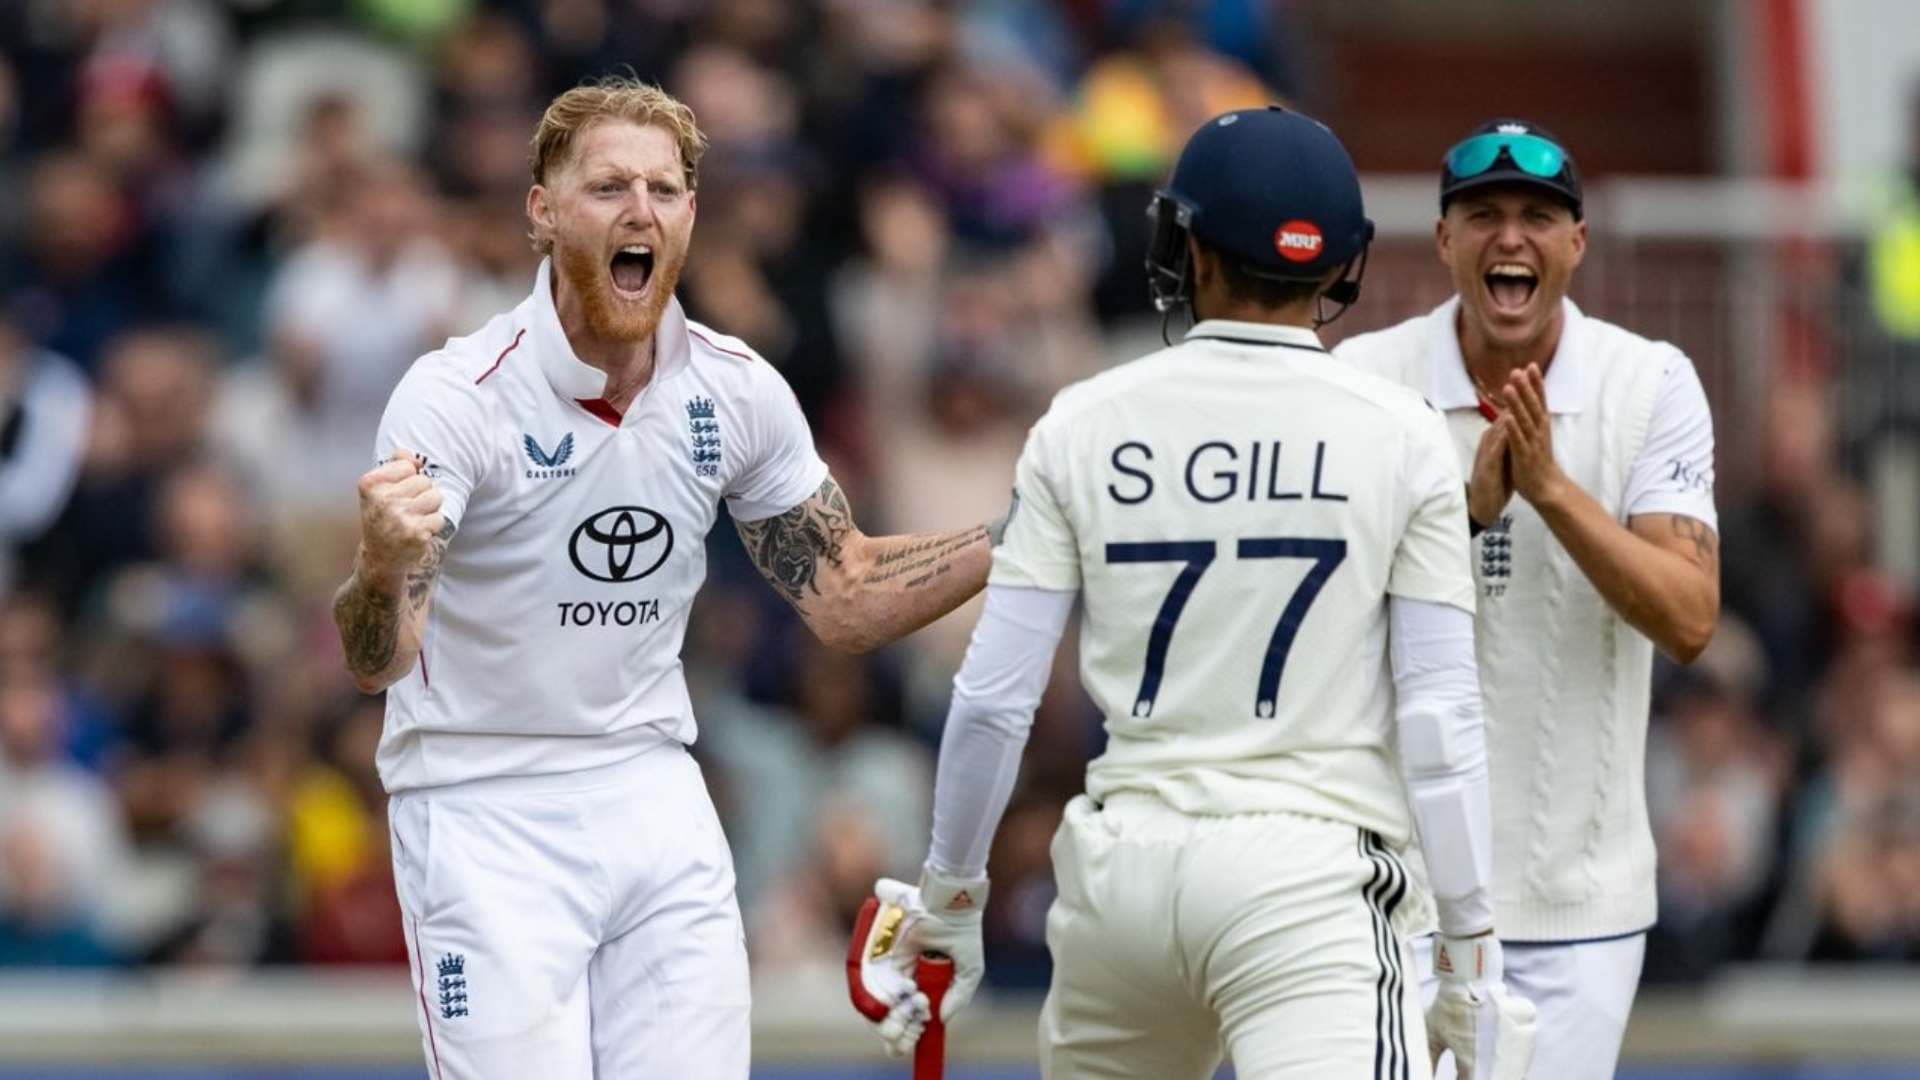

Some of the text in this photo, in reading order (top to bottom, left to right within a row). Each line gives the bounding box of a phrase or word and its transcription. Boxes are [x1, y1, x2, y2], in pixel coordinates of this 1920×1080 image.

[527, 468, 576, 479] CASTORE
[1107, 440, 1349, 505] S GILL
[557, 599, 660, 627] TOYOTA
[1105, 537, 1347, 718] 77
